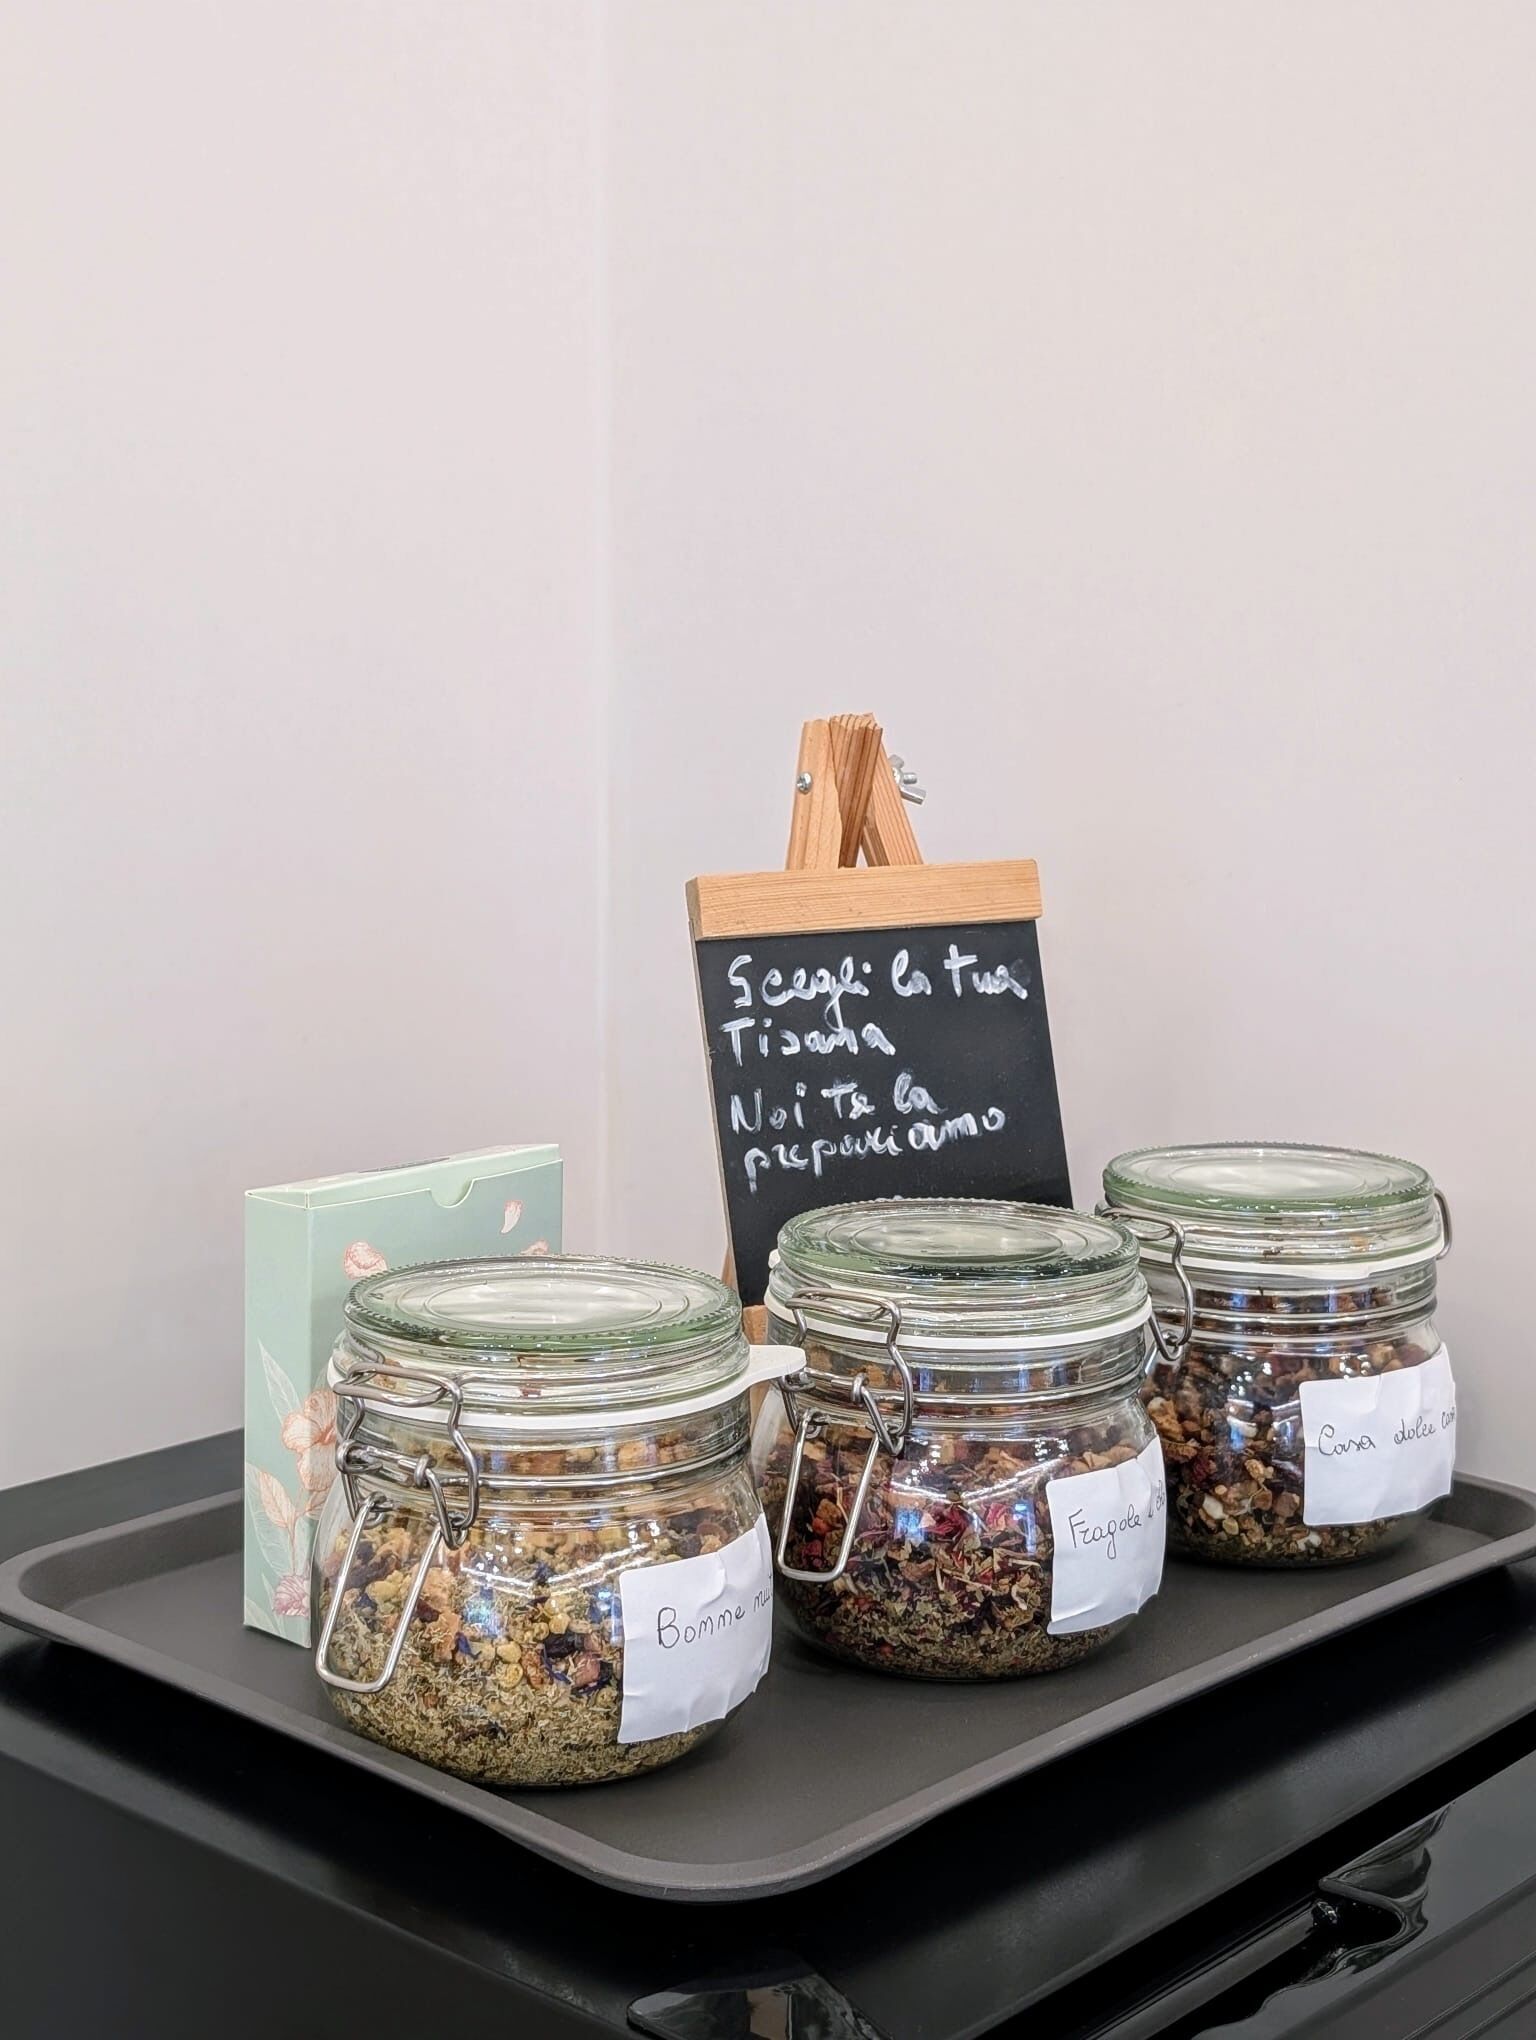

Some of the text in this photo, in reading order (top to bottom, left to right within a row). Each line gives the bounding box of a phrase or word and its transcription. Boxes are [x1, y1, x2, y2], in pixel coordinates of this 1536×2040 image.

[891, 949, 932, 997] la
[943, 943, 1028, 1000] tua
[720, 1016, 896, 1067] Tisana
[730, 1081, 808, 1134] Noi
[892, 1071, 945, 1115] la
[743, 1106, 1006, 1193] prepariamo
[1318, 1423, 1376, 1456] Casa
[1393, 1418, 1436, 1445] dolce
[1068, 1503, 1142, 1560] Fragole
